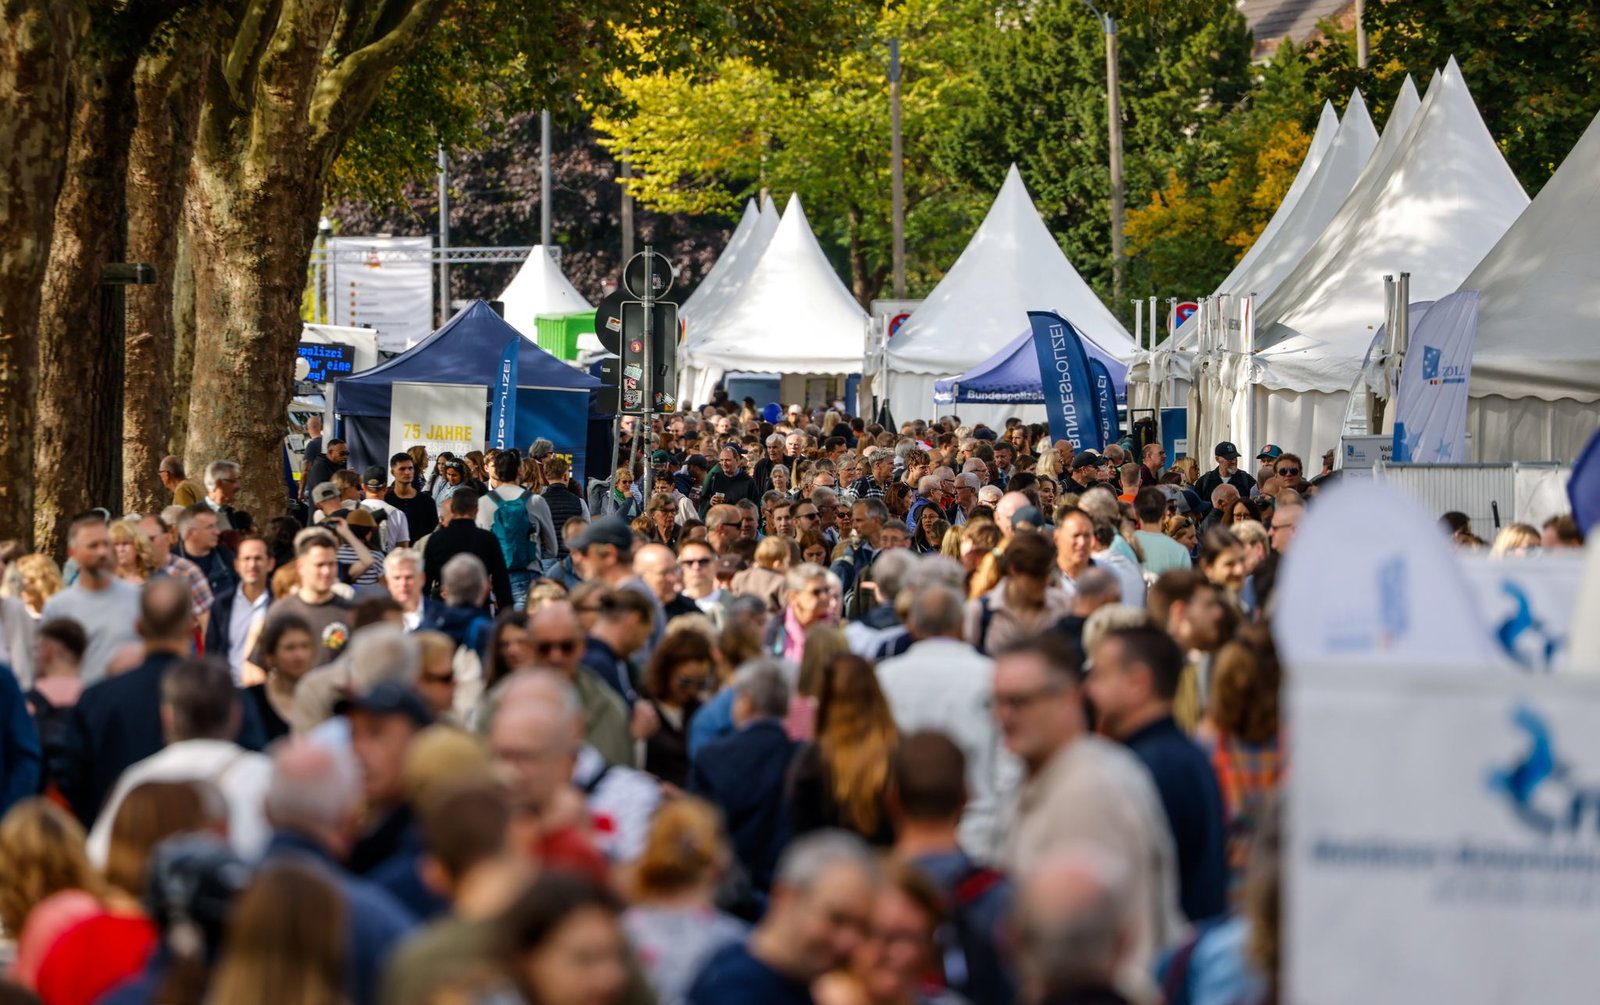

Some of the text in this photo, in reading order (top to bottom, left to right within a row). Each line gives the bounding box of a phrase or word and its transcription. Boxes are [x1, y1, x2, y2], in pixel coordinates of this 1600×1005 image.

[326, 360, 351, 372] eine
[402, 424, 473, 441] 75 JAHRE
